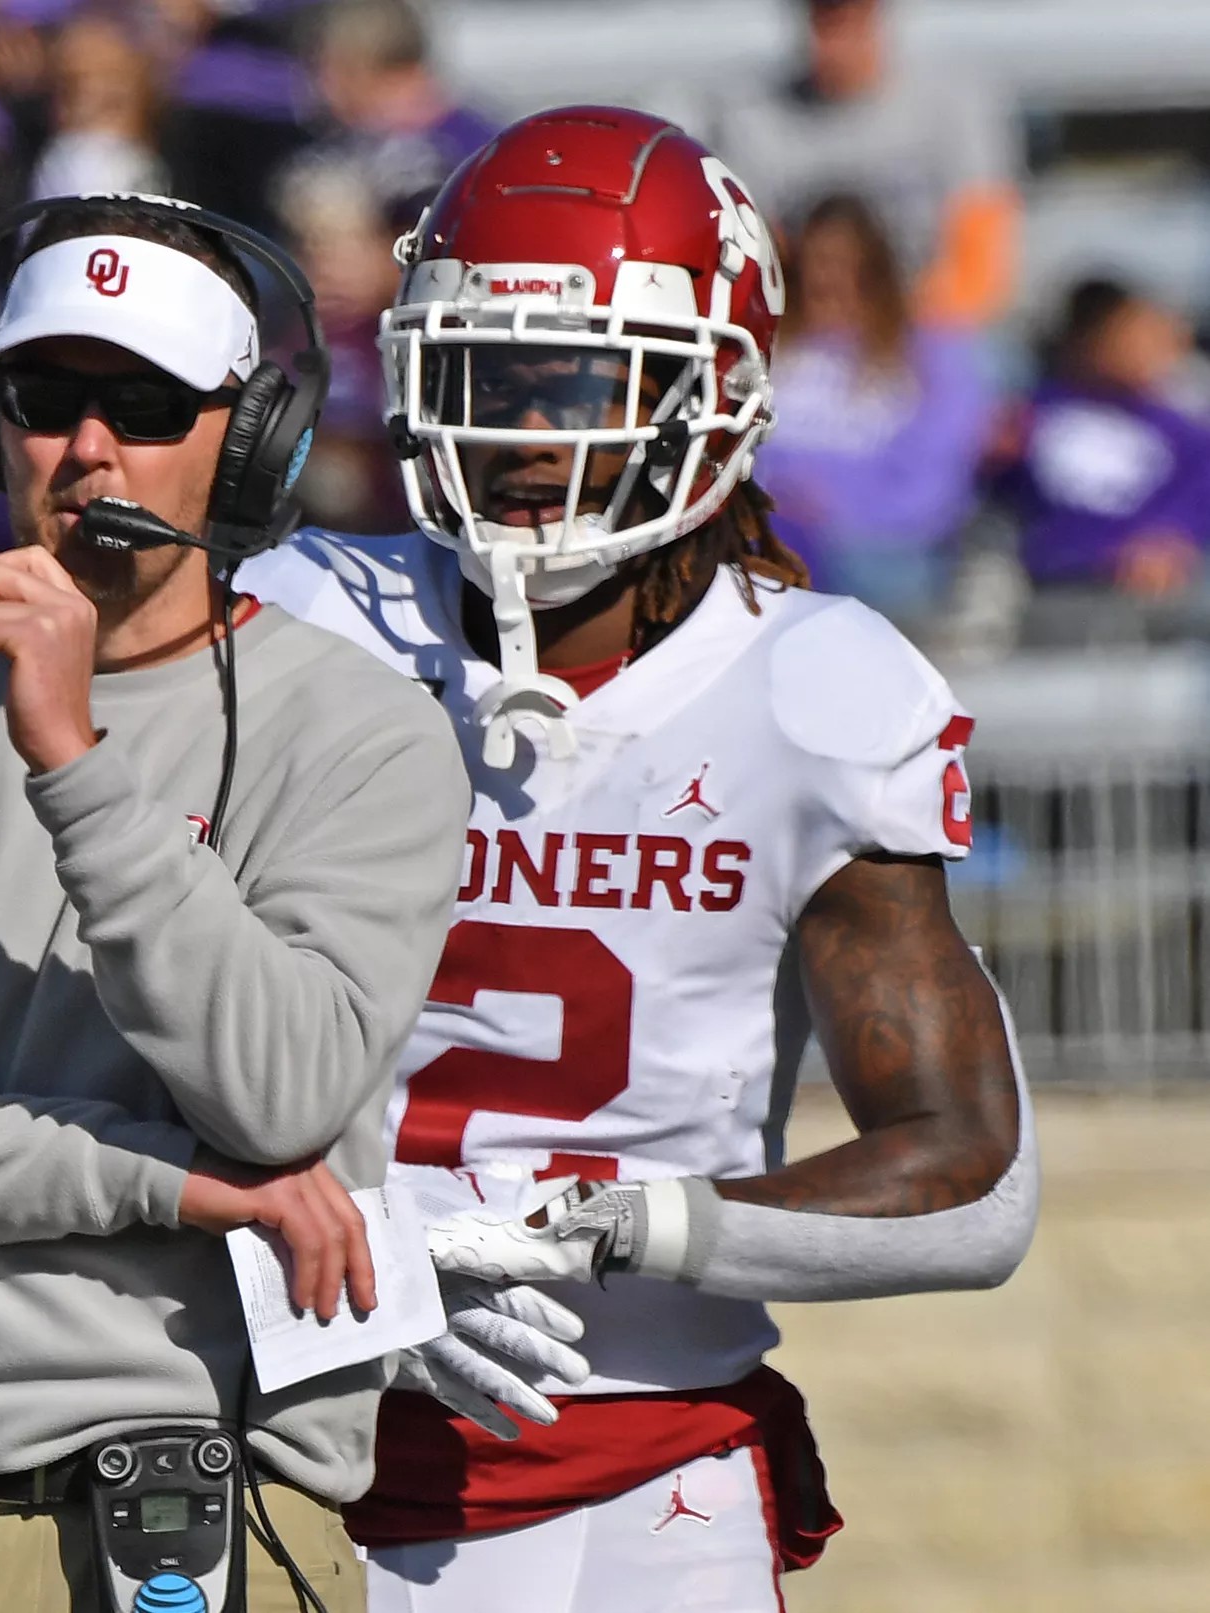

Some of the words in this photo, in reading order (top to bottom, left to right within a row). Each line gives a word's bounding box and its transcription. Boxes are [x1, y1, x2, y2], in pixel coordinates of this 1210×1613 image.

[86, 248, 130, 298] OU
[456, 828, 752, 913] ONERS
[393, 918, 634, 1184] 2
